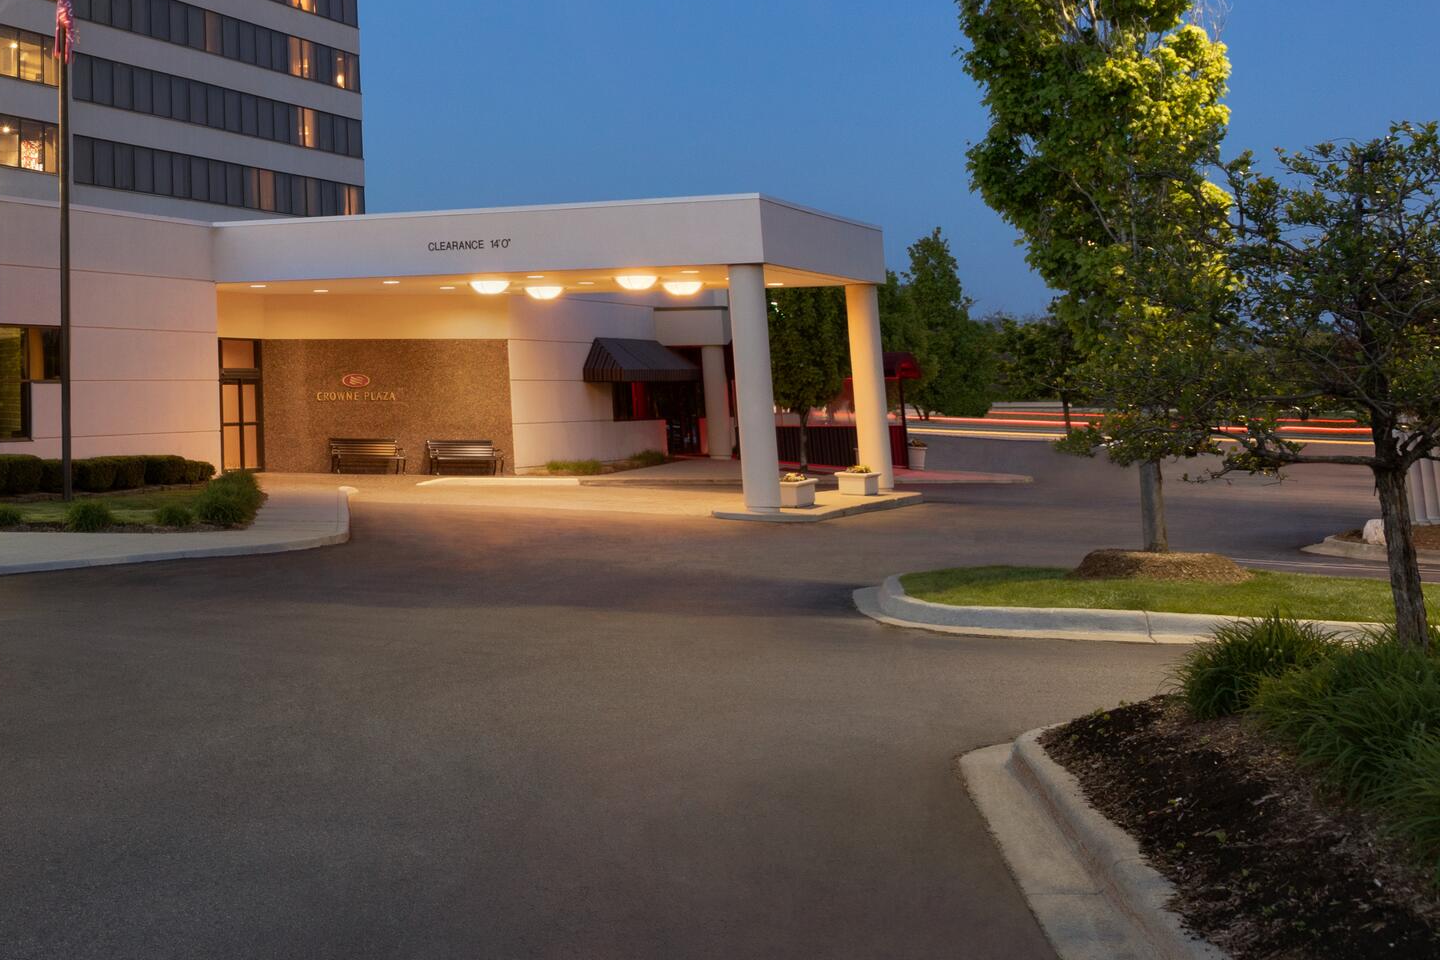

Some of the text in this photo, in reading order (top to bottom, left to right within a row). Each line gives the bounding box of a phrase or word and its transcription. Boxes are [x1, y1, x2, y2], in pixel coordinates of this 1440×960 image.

[427, 240, 485, 251] CLEARANCE
[316, 391, 396, 401] CROWNE PLAZA
